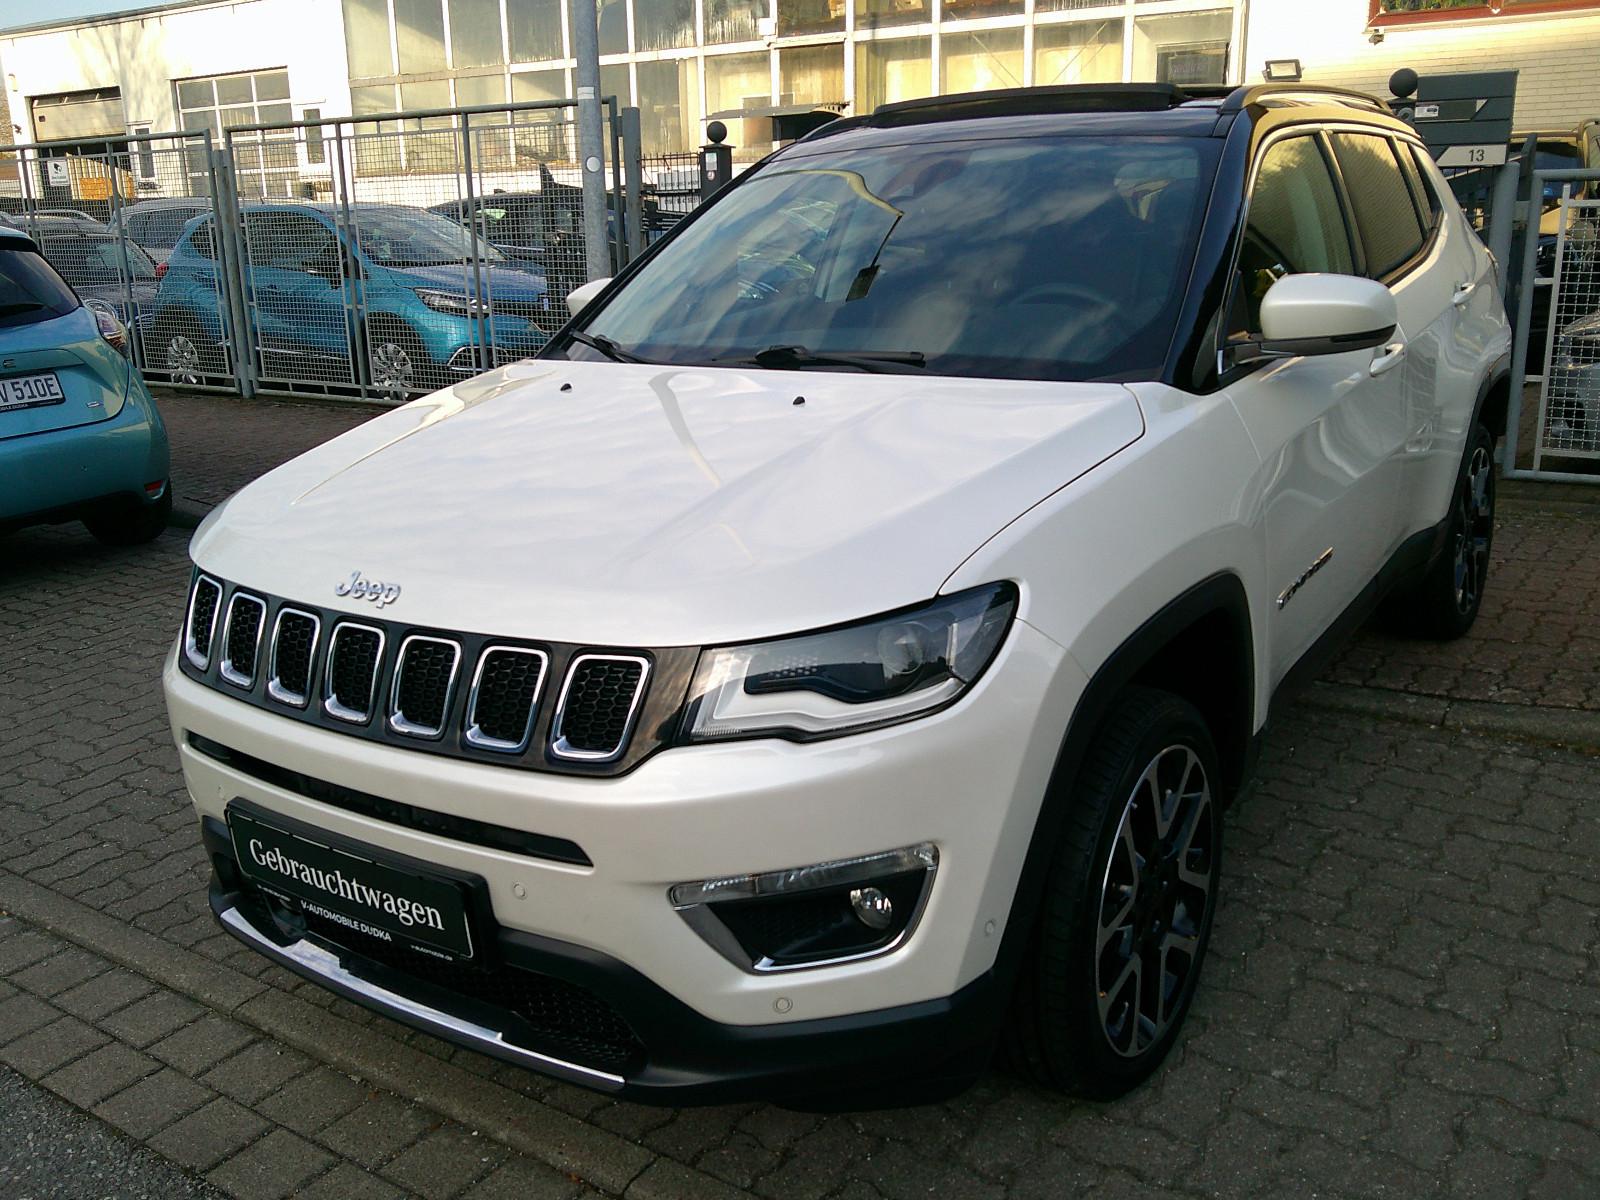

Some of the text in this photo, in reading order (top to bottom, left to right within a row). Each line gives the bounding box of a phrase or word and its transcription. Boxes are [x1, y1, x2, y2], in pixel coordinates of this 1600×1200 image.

[1468, 148, 1485, 162] 13
[10, 377, 60, 400] 510E
[335, 570, 401, 609] Jeep
[250, 839, 445, 931] Gebrauchtwagen
[300, 899, 393, 942] V-AUTOMOBILE DUDKA
